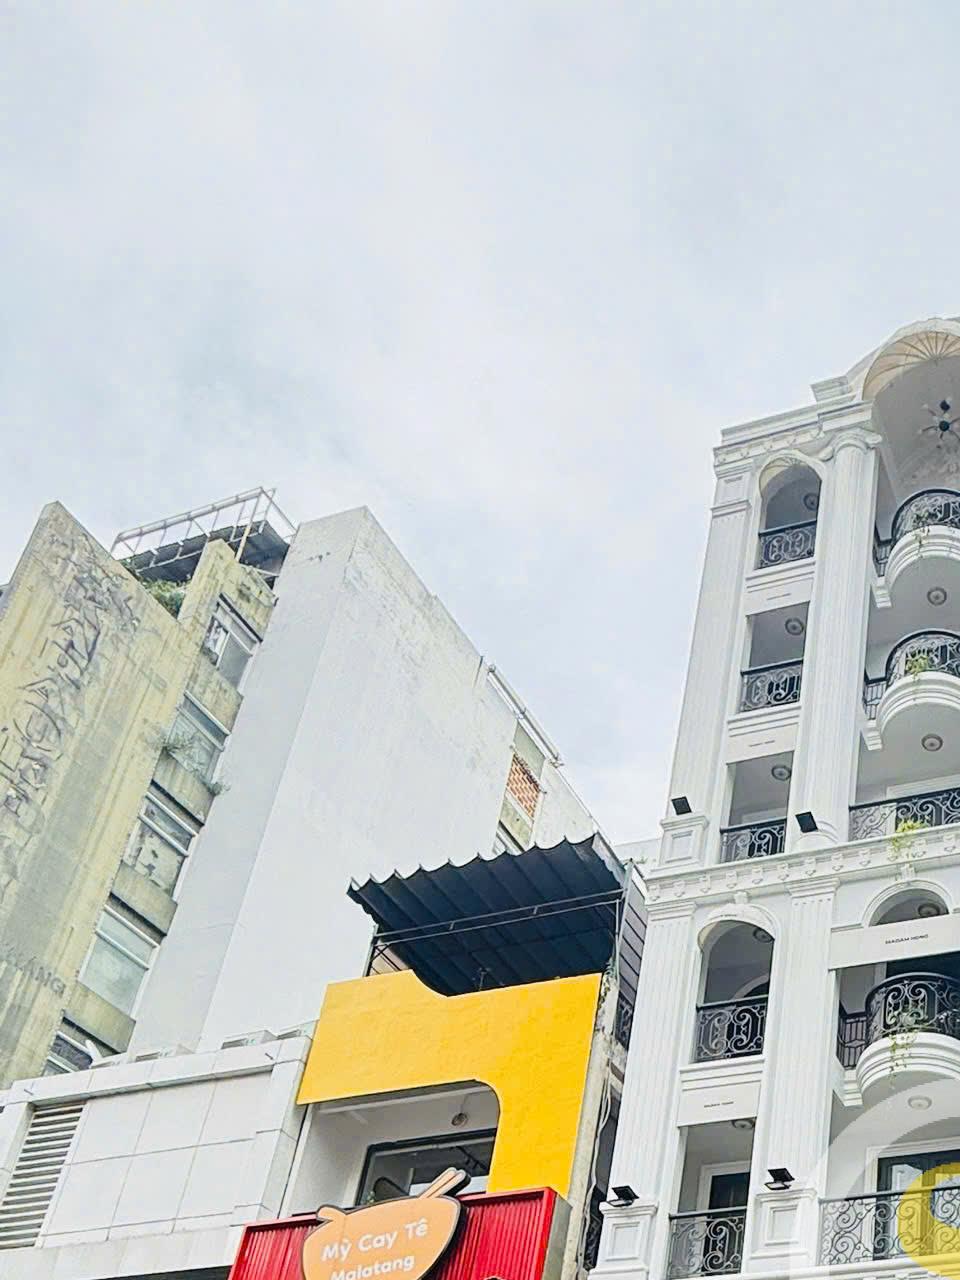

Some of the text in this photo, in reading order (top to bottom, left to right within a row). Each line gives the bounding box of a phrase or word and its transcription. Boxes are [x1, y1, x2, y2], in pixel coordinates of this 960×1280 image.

[321, 1217, 429, 1261] Mỳ Cay Tê
